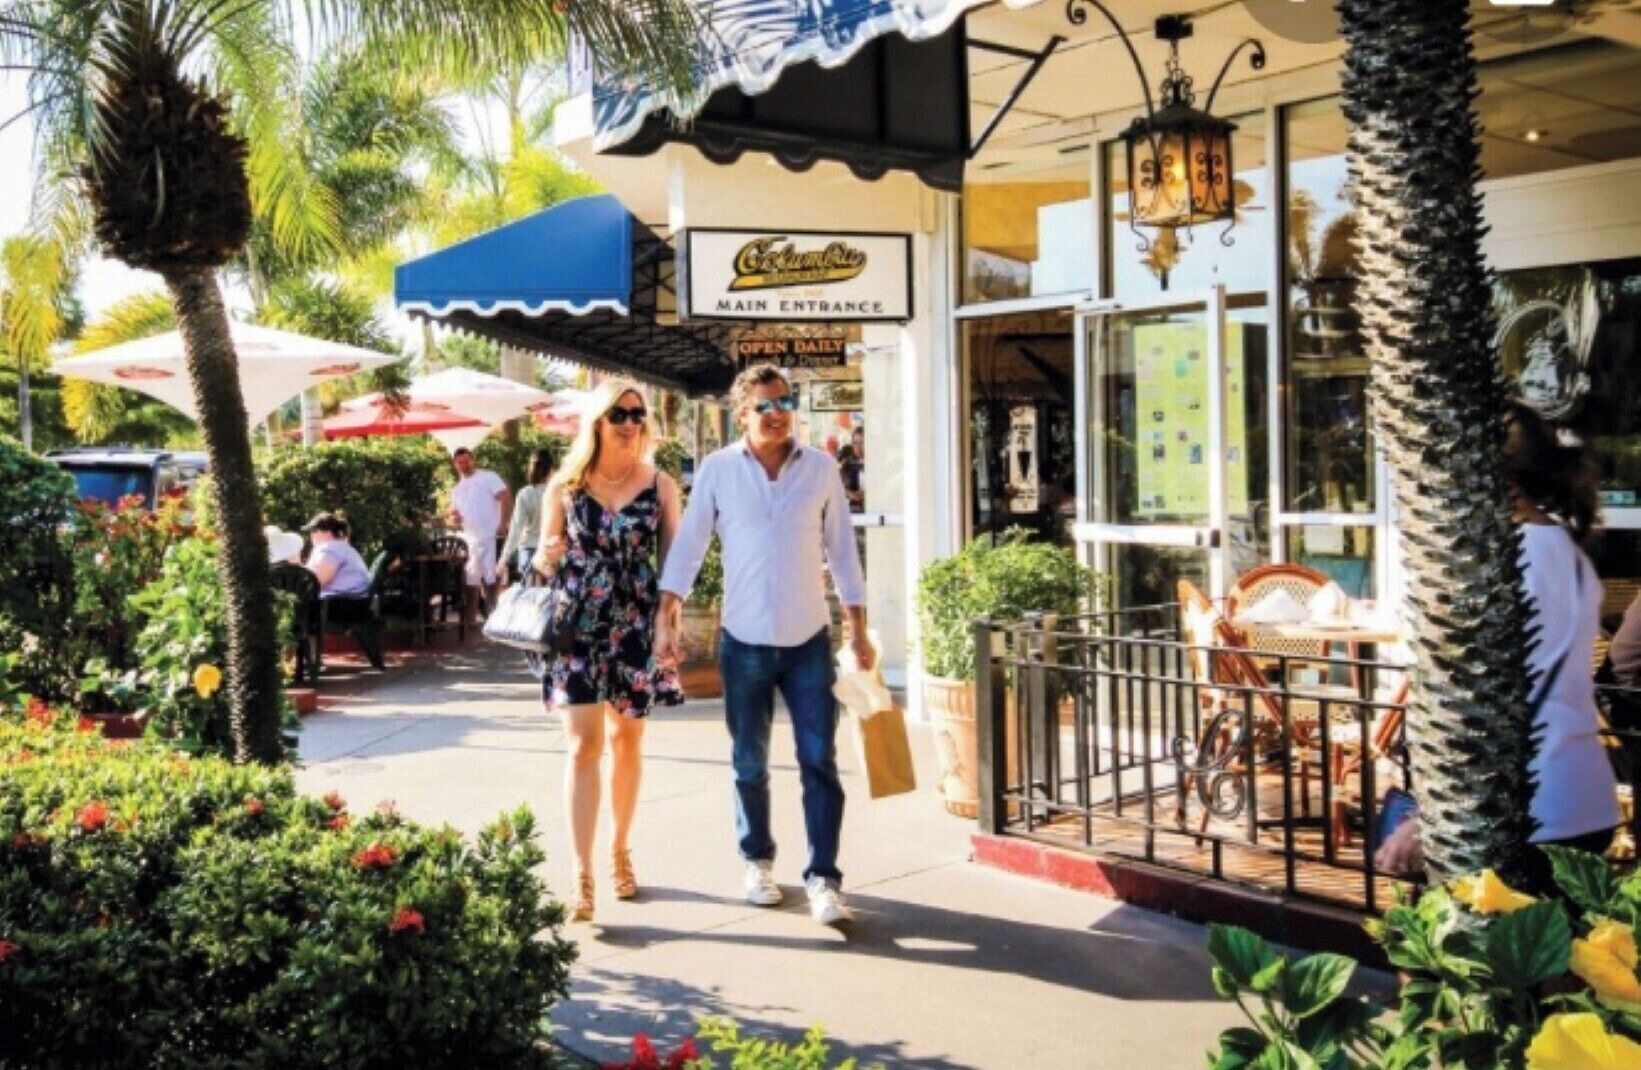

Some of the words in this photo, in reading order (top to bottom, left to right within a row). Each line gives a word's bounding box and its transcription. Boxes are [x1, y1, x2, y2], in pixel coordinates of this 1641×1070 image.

[716, 299, 767, 312] MAIN
[779, 299, 884, 313] ENTRANCE
[740, 340, 786, 354] OPEN
[794, 338, 844, 352] DAILY
